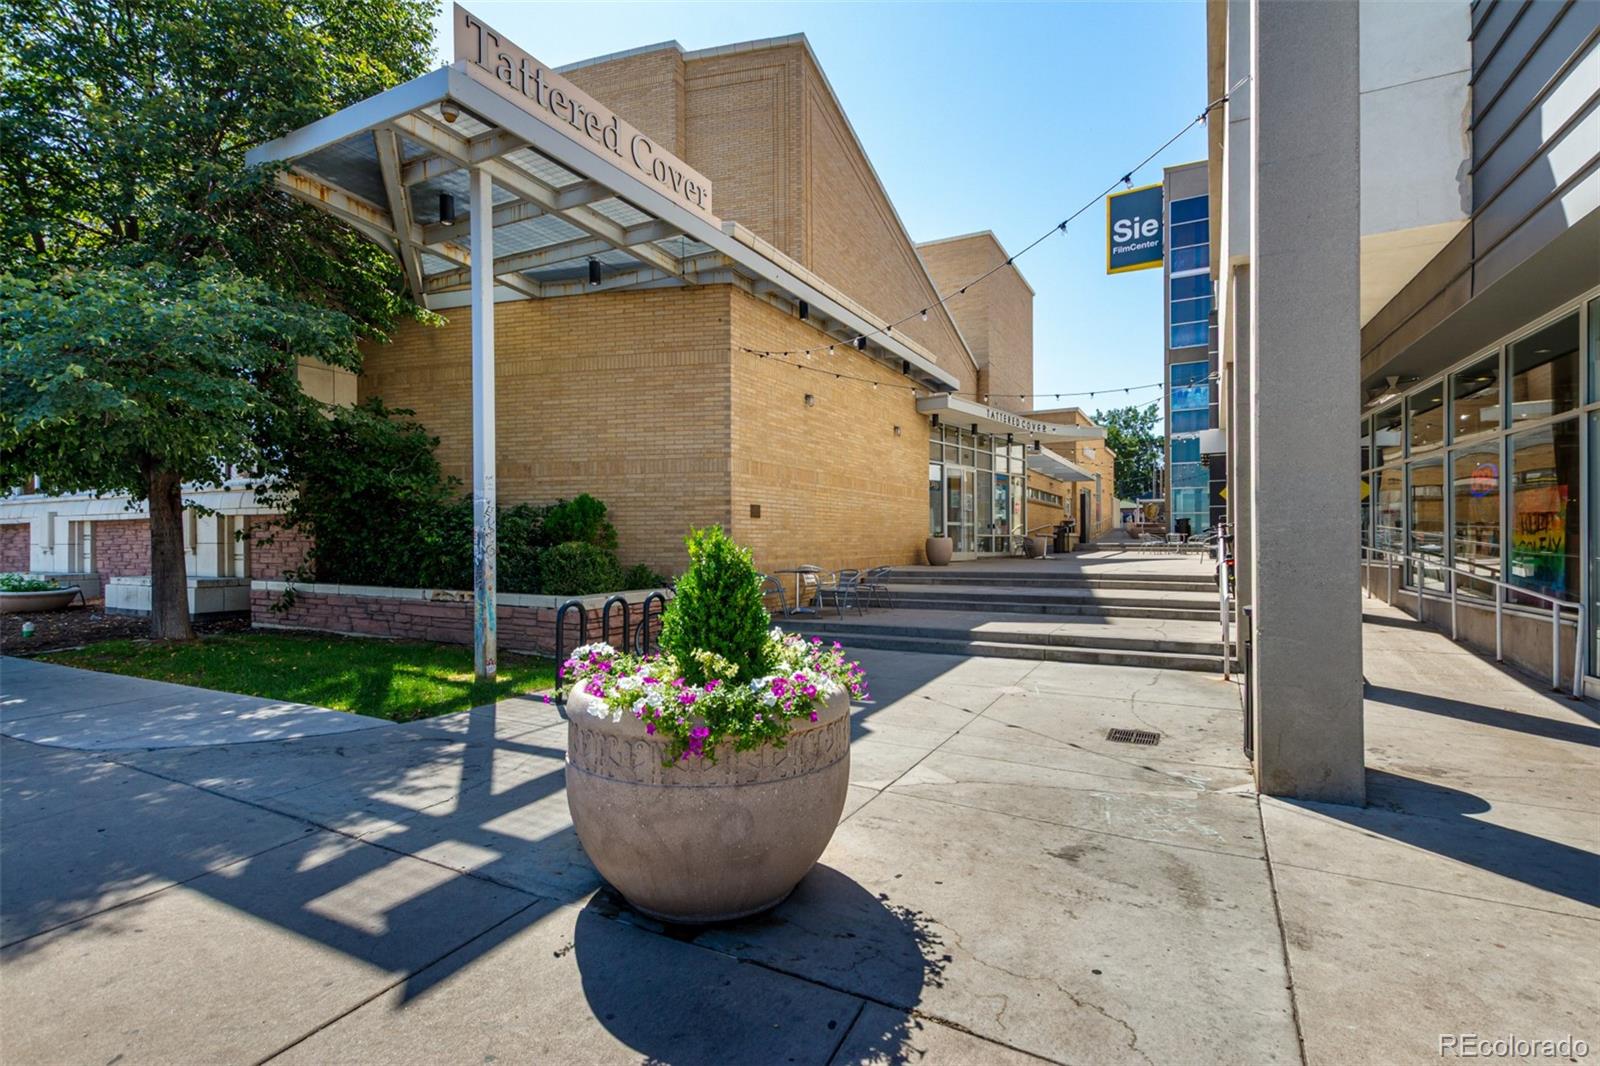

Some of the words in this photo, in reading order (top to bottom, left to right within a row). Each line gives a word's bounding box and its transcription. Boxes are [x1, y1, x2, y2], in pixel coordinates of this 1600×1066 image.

[465, 15, 623, 157] Tattered
[630, 135, 708, 210] Cover
[1113, 216, 1159, 243] Sie
[1112, 240, 1159, 255] FilmCenter
[986, 408, 1020, 427] TATTERED
[1021, 420, 1047, 432] COVER
